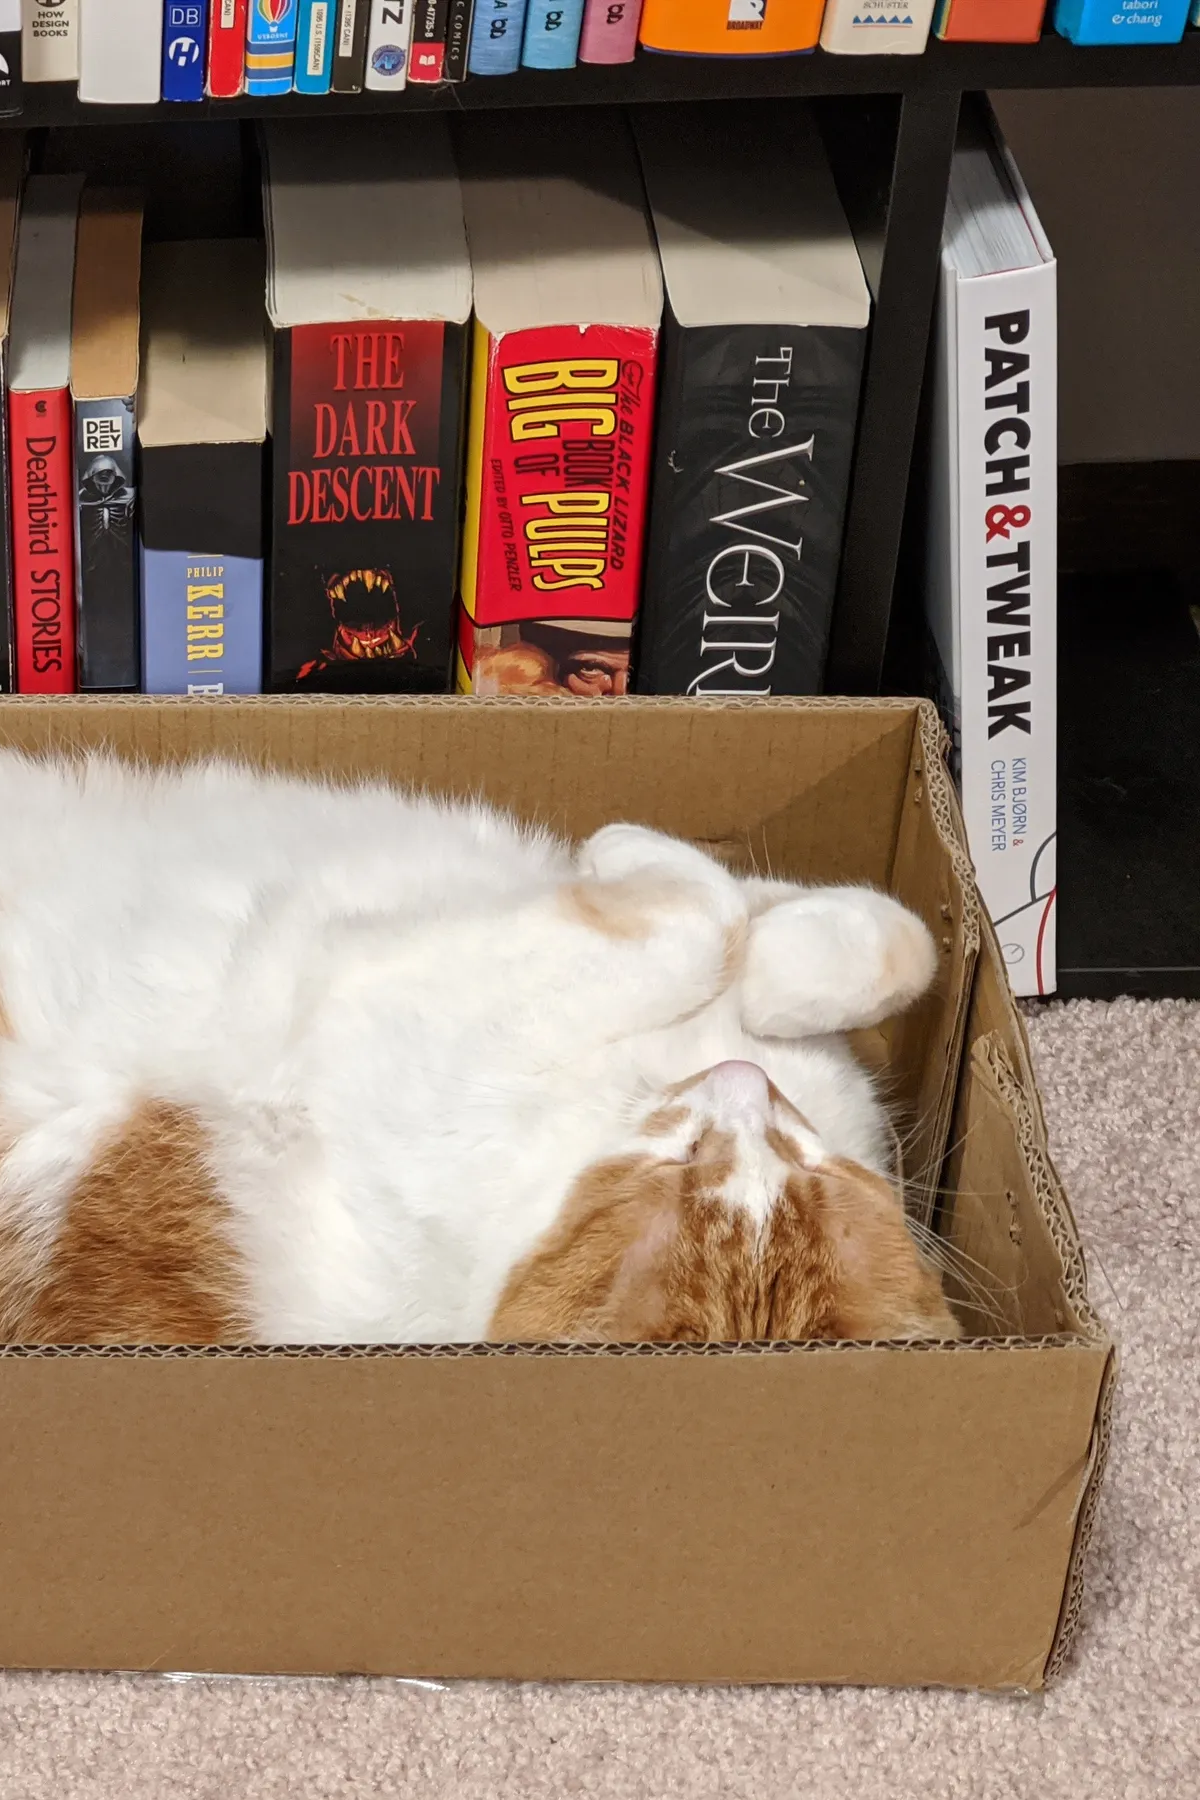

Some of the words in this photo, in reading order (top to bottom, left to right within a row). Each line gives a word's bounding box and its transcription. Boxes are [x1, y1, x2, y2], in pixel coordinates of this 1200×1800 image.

[32, 20, 69, 28] DESIGN
[37, 11, 64, 19] HOW
[172, 8, 199, 25] DB
[451, 15, 464, 60] COMICS
[727, 21, 763, 30] BROADWAY
[1126, 13, 1163, 27] chang
[330, 331, 405, 392] THE
[502, 357, 621, 442] BIG
[620, 359, 644, 416] The
[984, 308, 1031, 497] PATCH
[85, 420, 120, 435] DEL
[86, 435, 121, 450] REY
[313, 399, 417, 460] DARK
[491, 459, 506, 499] EDITED
[514, 452, 560, 476] OF
[562, 439, 616, 488] BOOK
[614, 420, 634, 495] BLACK
[25, 435, 59, 556] Deathbird
[287, 466, 440, 526] DESCENT
[499, 500, 508, 511] BY
[498, 512, 514, 539] OTTO
[520, 490, 611, 592] PULPS
[610, 496, 630, 571] LIZARD
[984, 504, 1031, 544] &
[187, 566, 224, 578] PHILIP
[504, 542, 521, 592] PENZLER
[30, 569, 62, 674] STORIES
[187, 583, 224, 661] KERR
[986, 540, 1031, 741] TWEAK
[991, 760, 1006, 801] CHRIS
[1012, 757, 1027, 783] KIM
[991, 803, 1006, 852] MEYER
[1012, 787, 1027, 835] BJØRN
